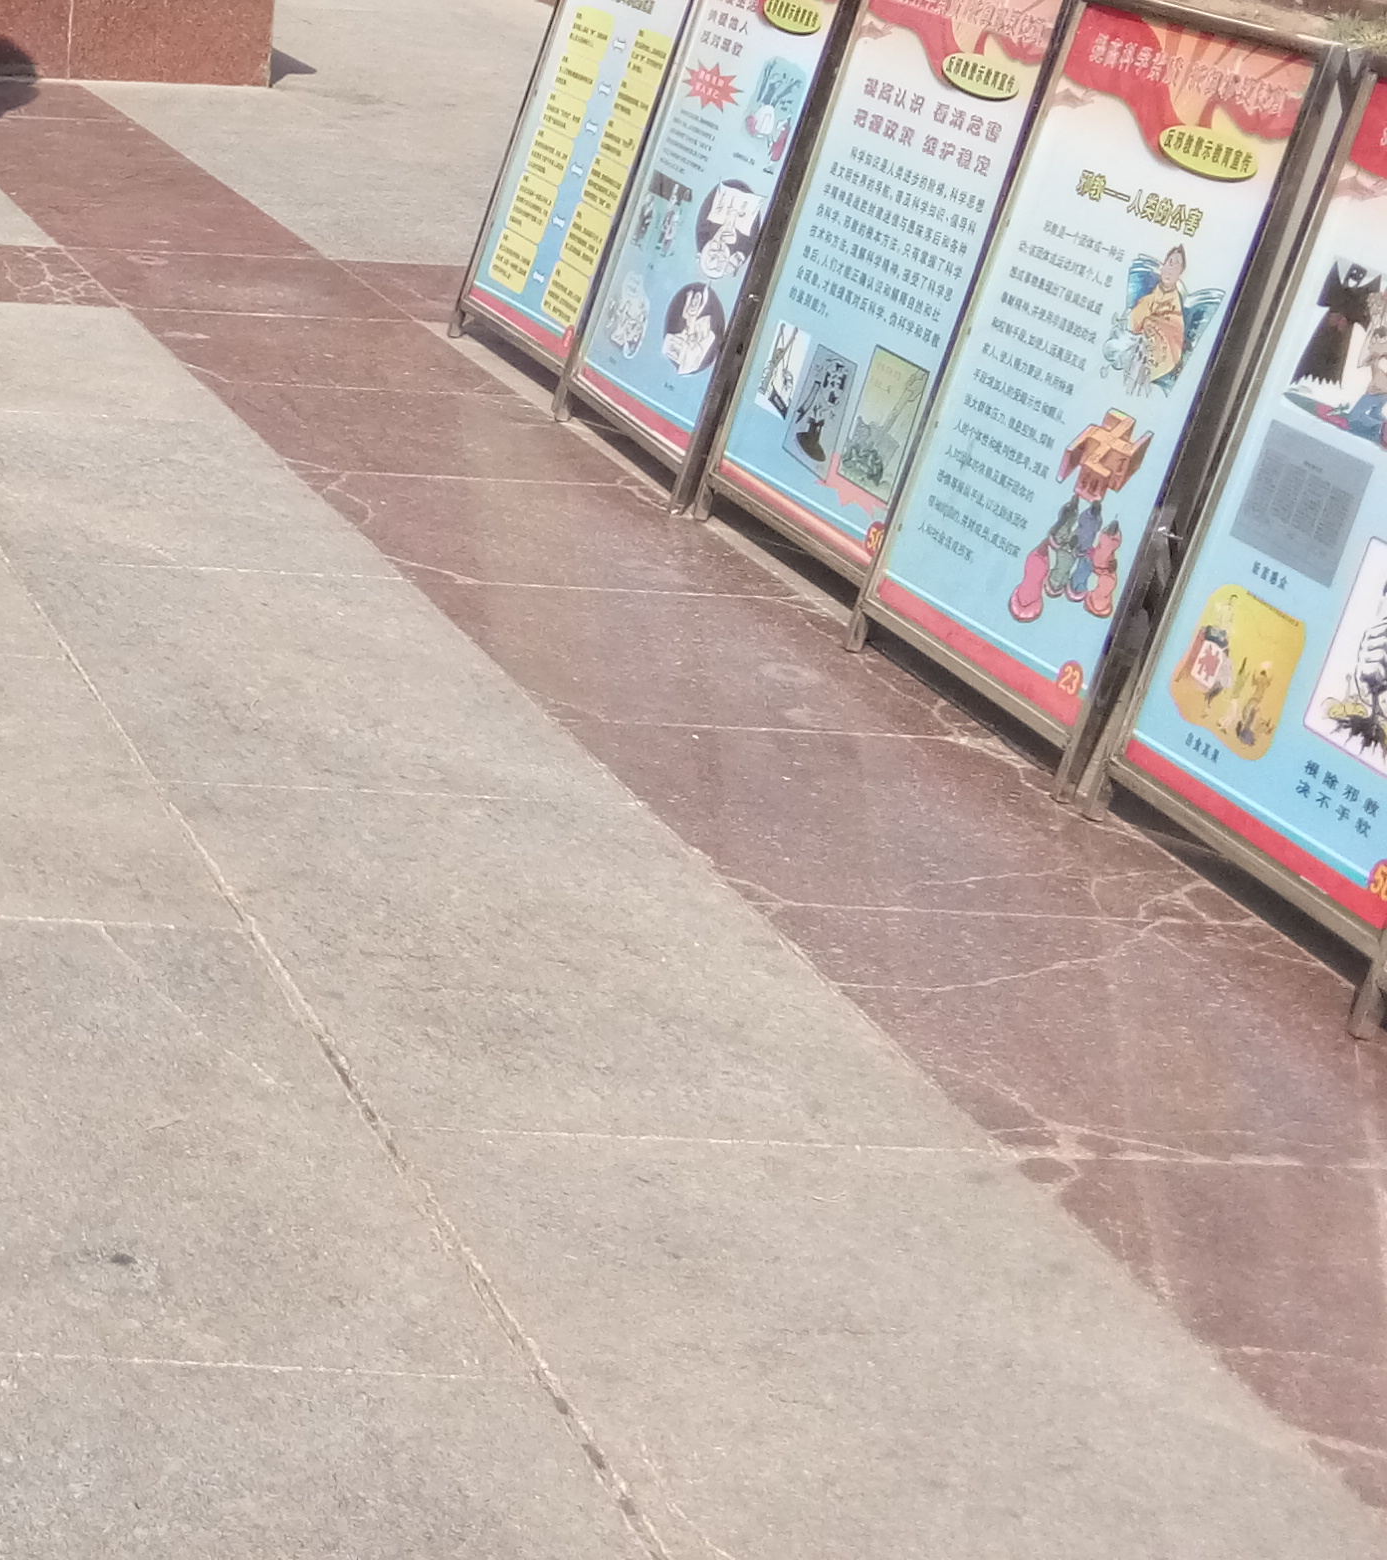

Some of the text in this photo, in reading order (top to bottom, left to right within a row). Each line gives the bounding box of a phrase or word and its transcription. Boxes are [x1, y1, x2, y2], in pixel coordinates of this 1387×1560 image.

[863, 77, 1003, 144] 提高认识 看清危害
[853, 107, 992, 177] 把握政策 维护稳定
[1163, 128, 1253, 173] 反邪教警示教育宣传
[1058, 666, 1081, 696] 23
[1295, 779, 1372, 839] 决不手软
[1303, 759, 1380, 819] 根除邪教
